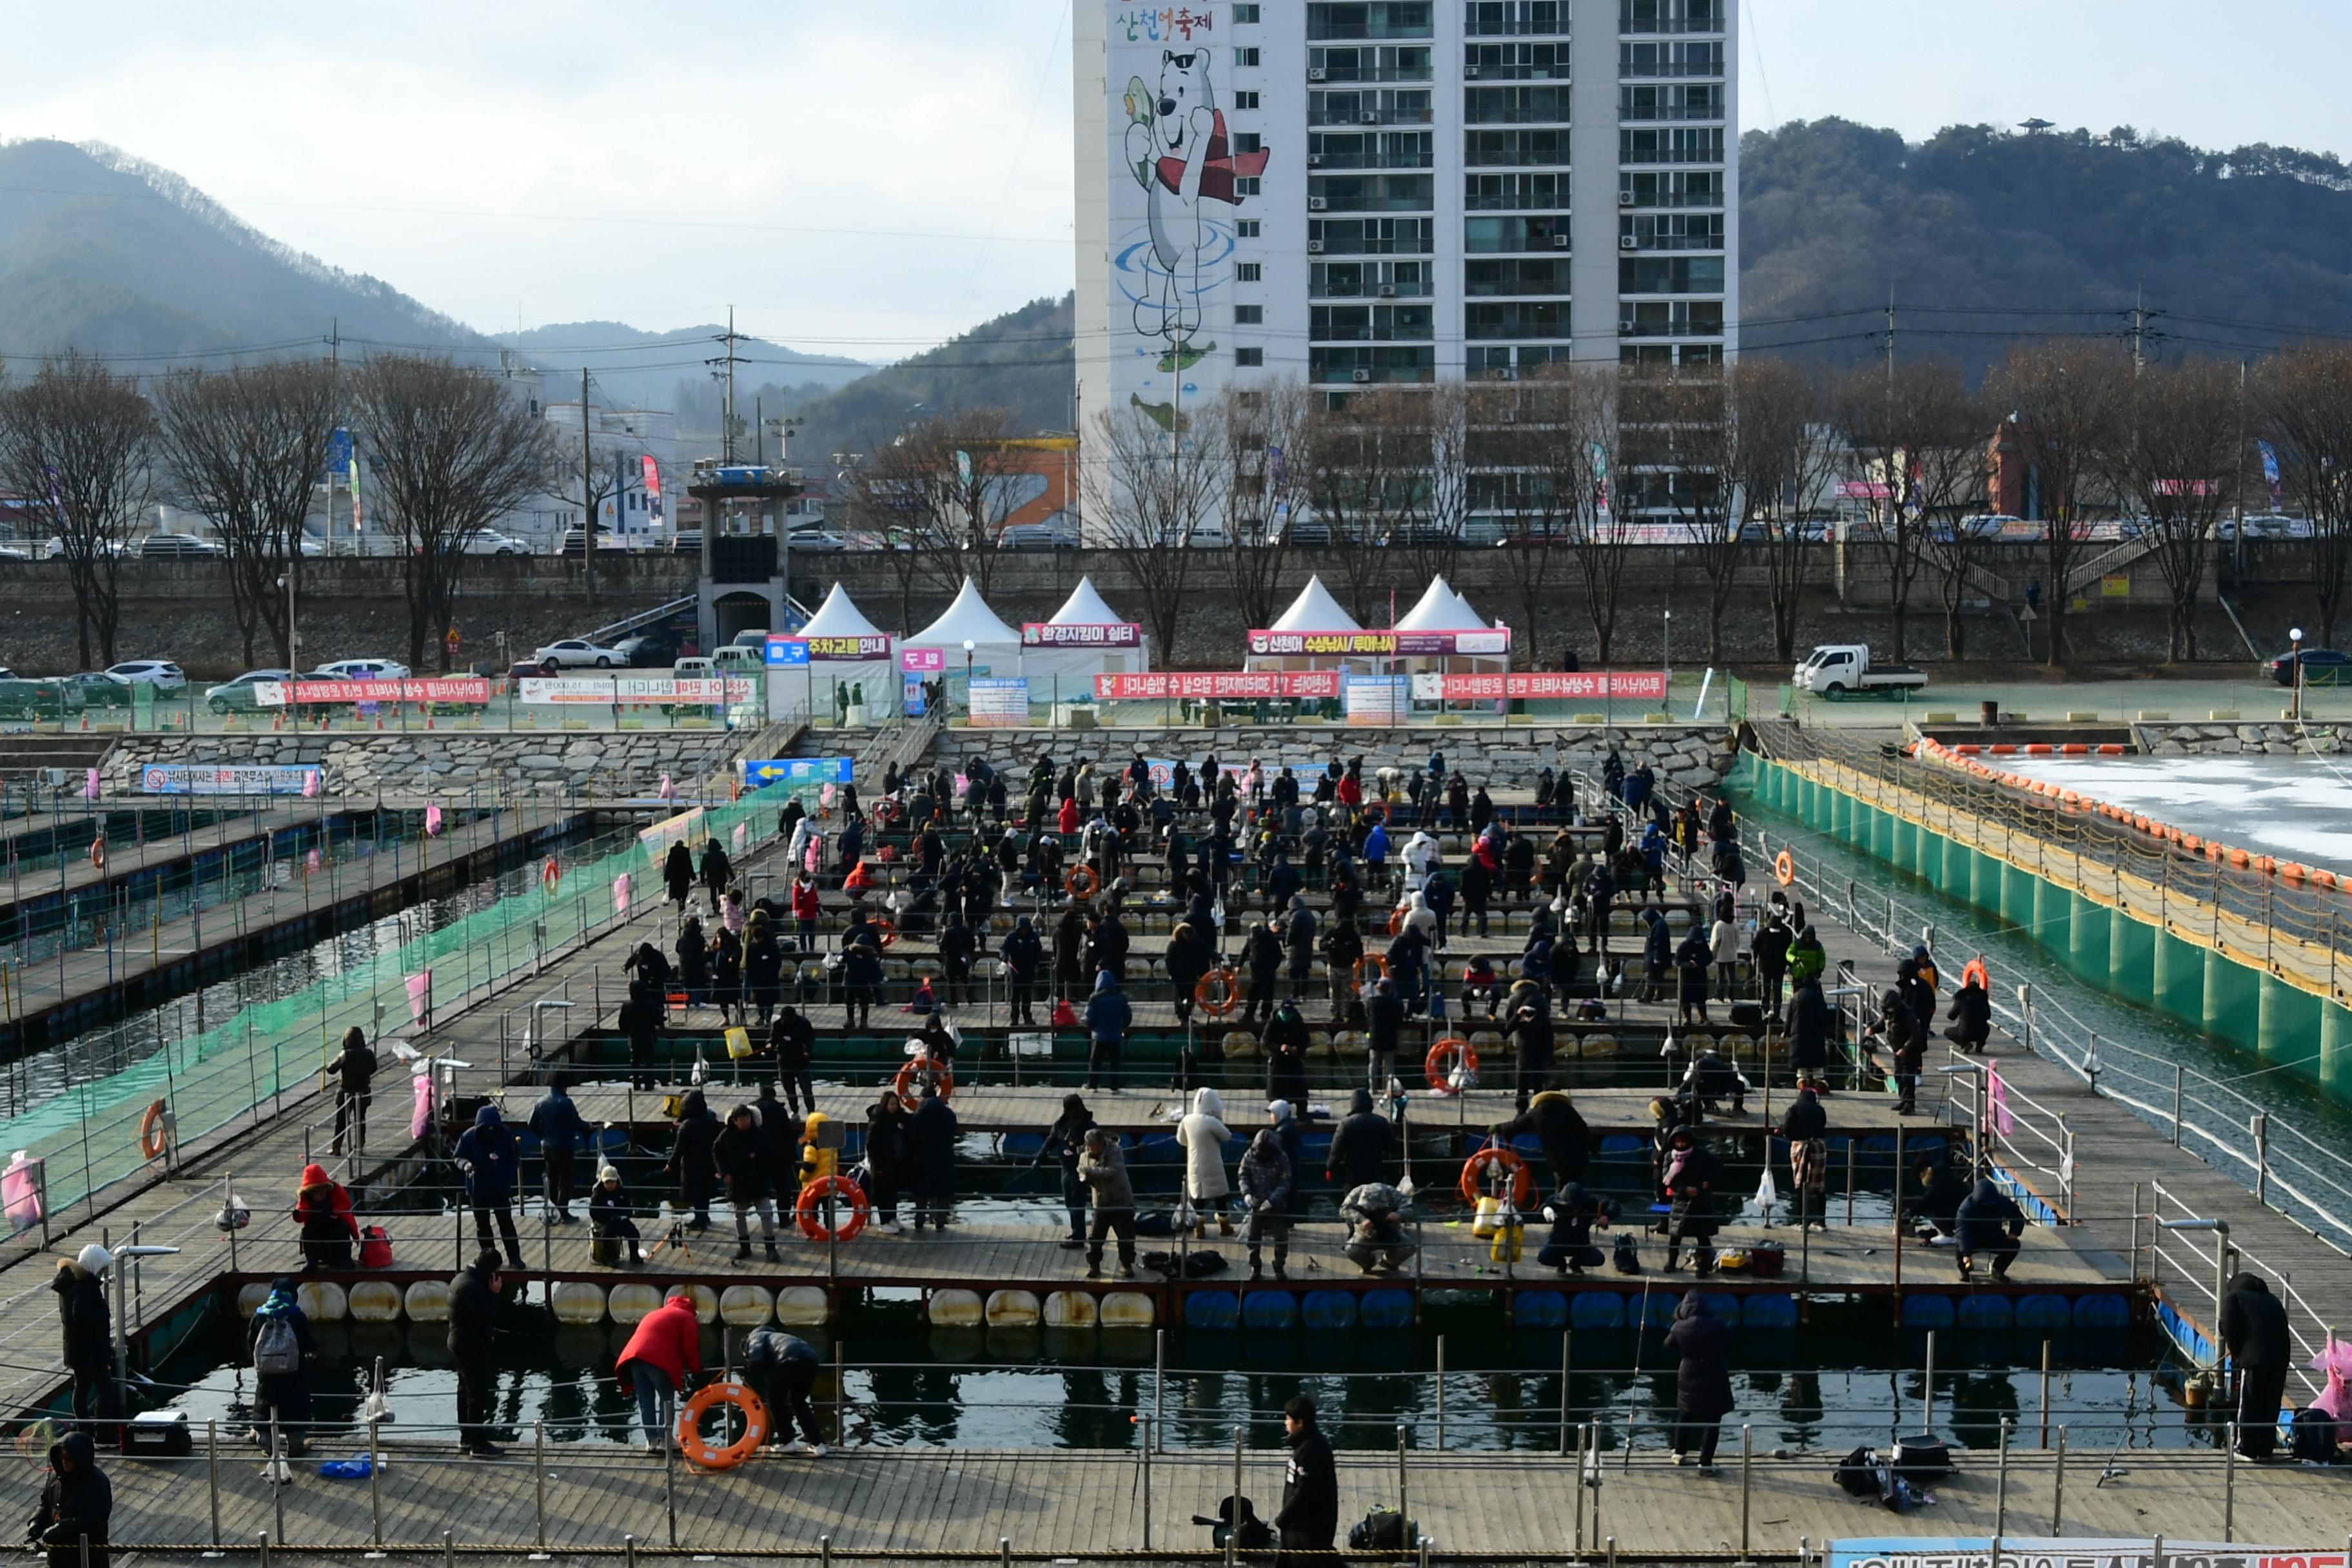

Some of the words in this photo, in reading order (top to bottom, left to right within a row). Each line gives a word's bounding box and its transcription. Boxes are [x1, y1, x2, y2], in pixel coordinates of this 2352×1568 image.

[1117, 7, 1212, 42] 산천어축제
[1042, 626, 1104, 641] 환경지킴이
[1108, 626, 1133, 641] 쉼터
[808, 638, 885, 654] 주차교통안내
[1270, 636, 1302, 652] 산천어
